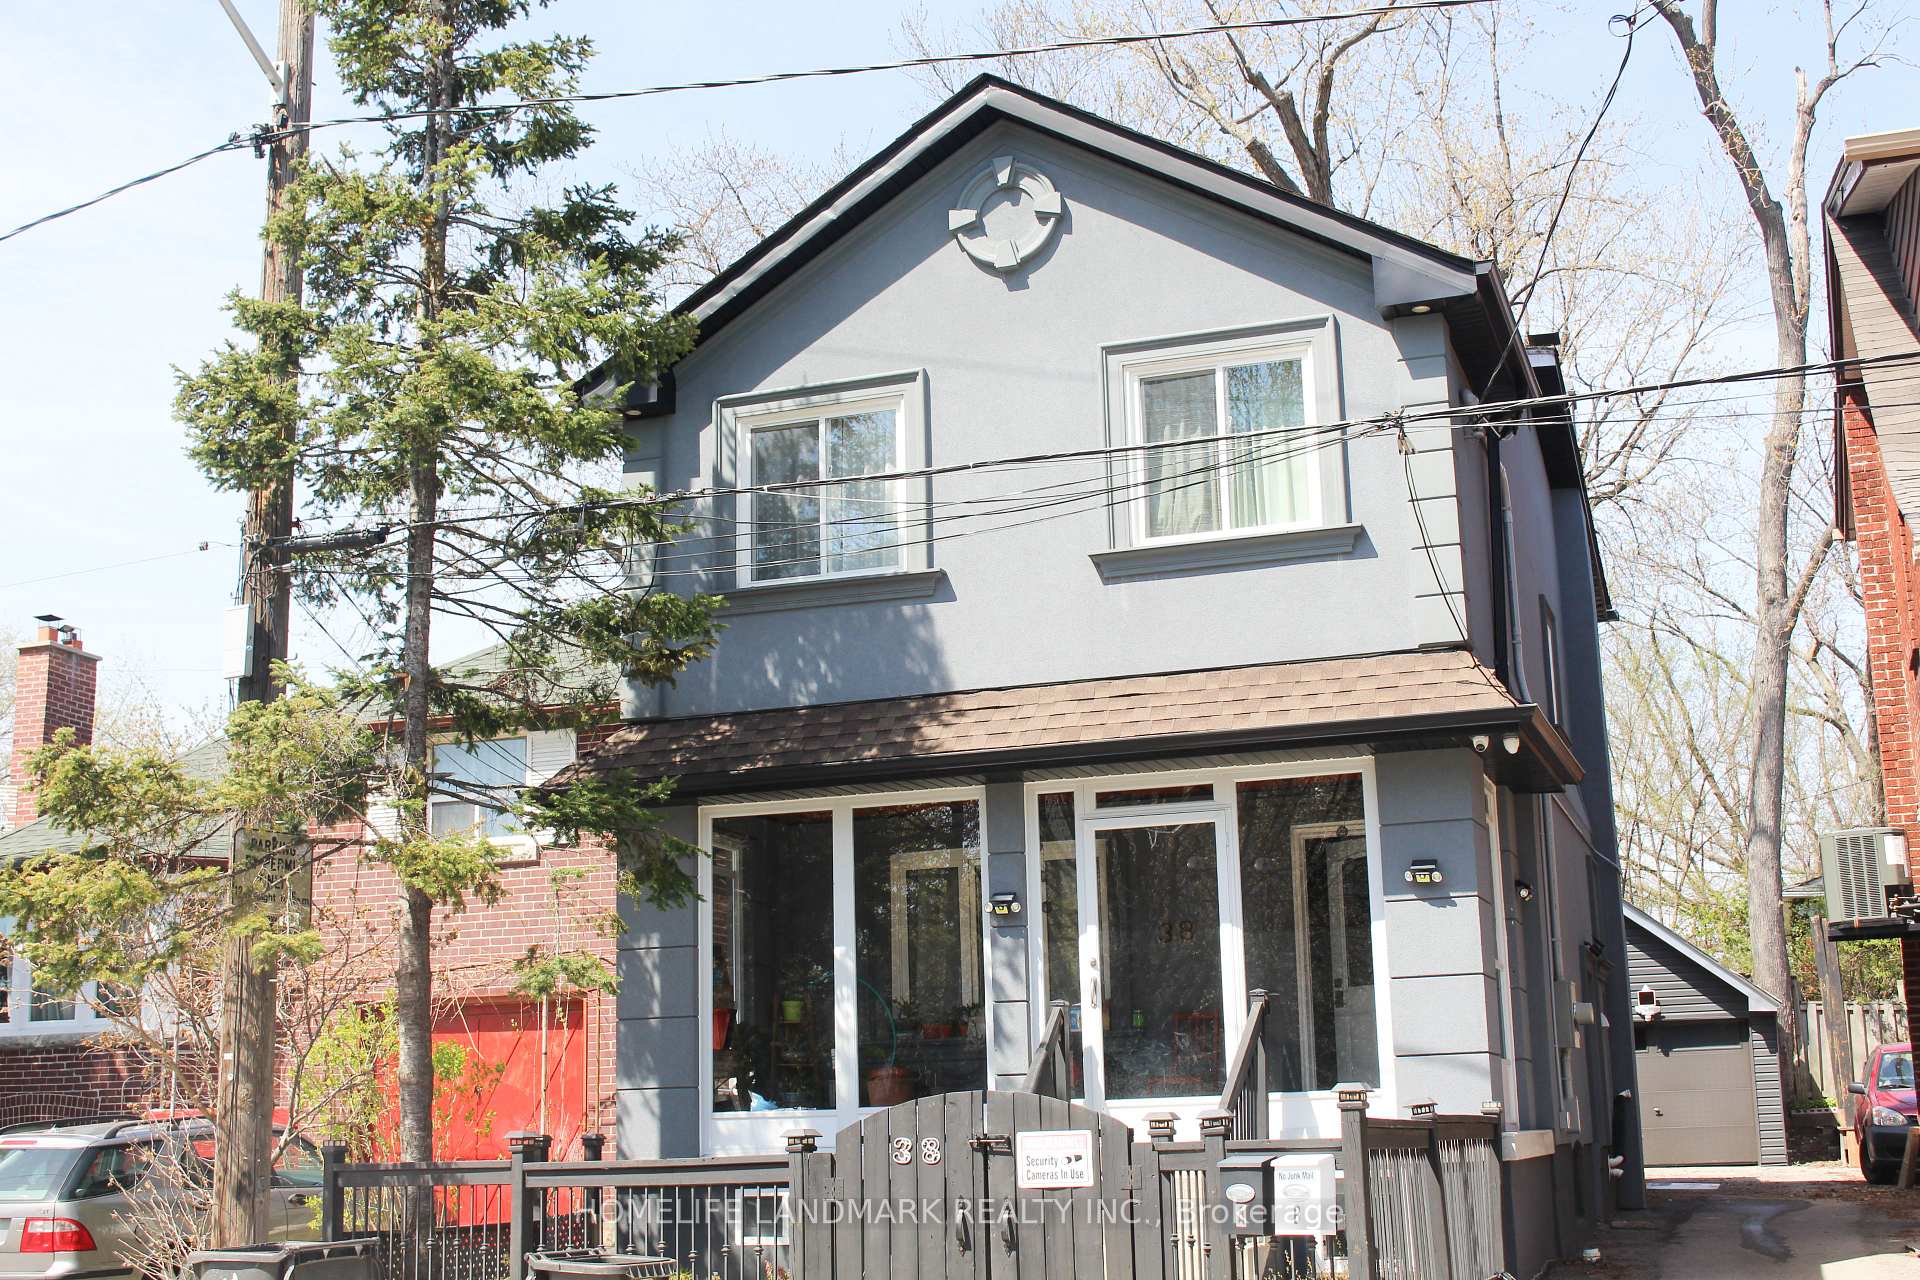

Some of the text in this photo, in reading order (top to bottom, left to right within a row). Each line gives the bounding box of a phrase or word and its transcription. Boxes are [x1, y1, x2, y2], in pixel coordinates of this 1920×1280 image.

[1159, 920, 1194, 943] 38
[892, 1137, 941, 1165] 38
[1026, 1155, 1059, 1168] Security
[1026, 1169, 1084, 1181] Cameras In Use
[1279, 1171, 1314, 1180] No Junk Mail
